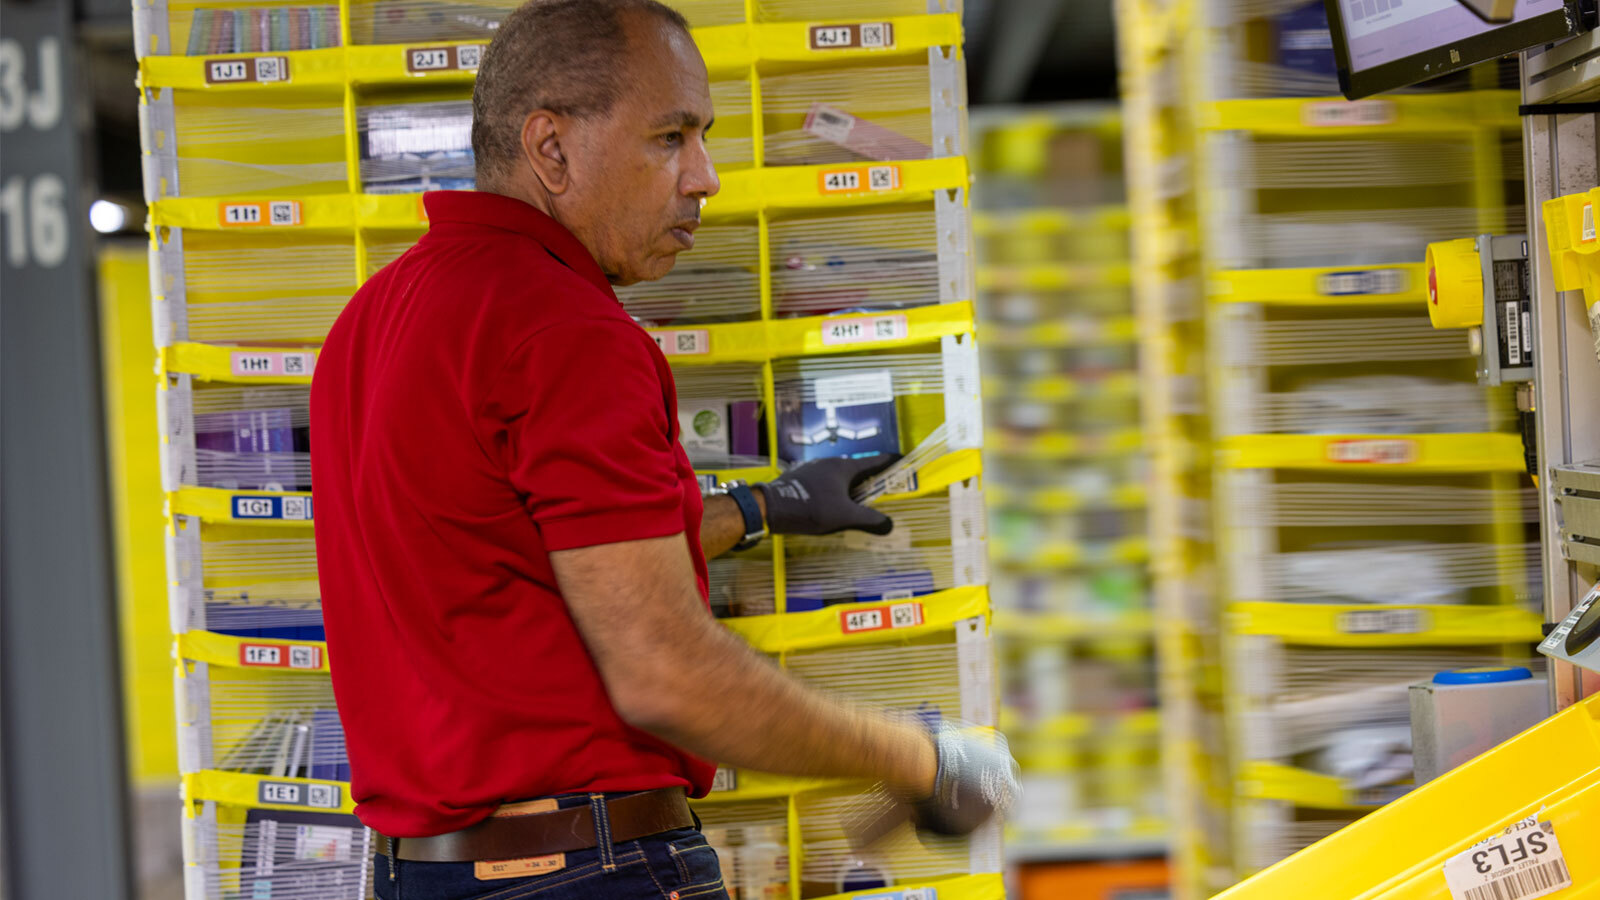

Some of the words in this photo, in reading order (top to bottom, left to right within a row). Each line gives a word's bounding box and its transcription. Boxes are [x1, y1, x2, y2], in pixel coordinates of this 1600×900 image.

[819, 31, 837, 43] 4J
[416, 53, 434, 66] 2J
[215, 64, 232, 77] 1J
[0, 36, 62, 131] 3J
[0, 173, 68, 268] 16
[831, 325, 853, 336] 4H
[241, 358, 262, 369] 1H
[242, 501, 262, 514] 1G
[848, 614, 868, 626] 4F
[249, 649, 266, 661] 1F
[268, 787, 285, 799] 1E
[1472, 831, 1548, 874] SFL3
